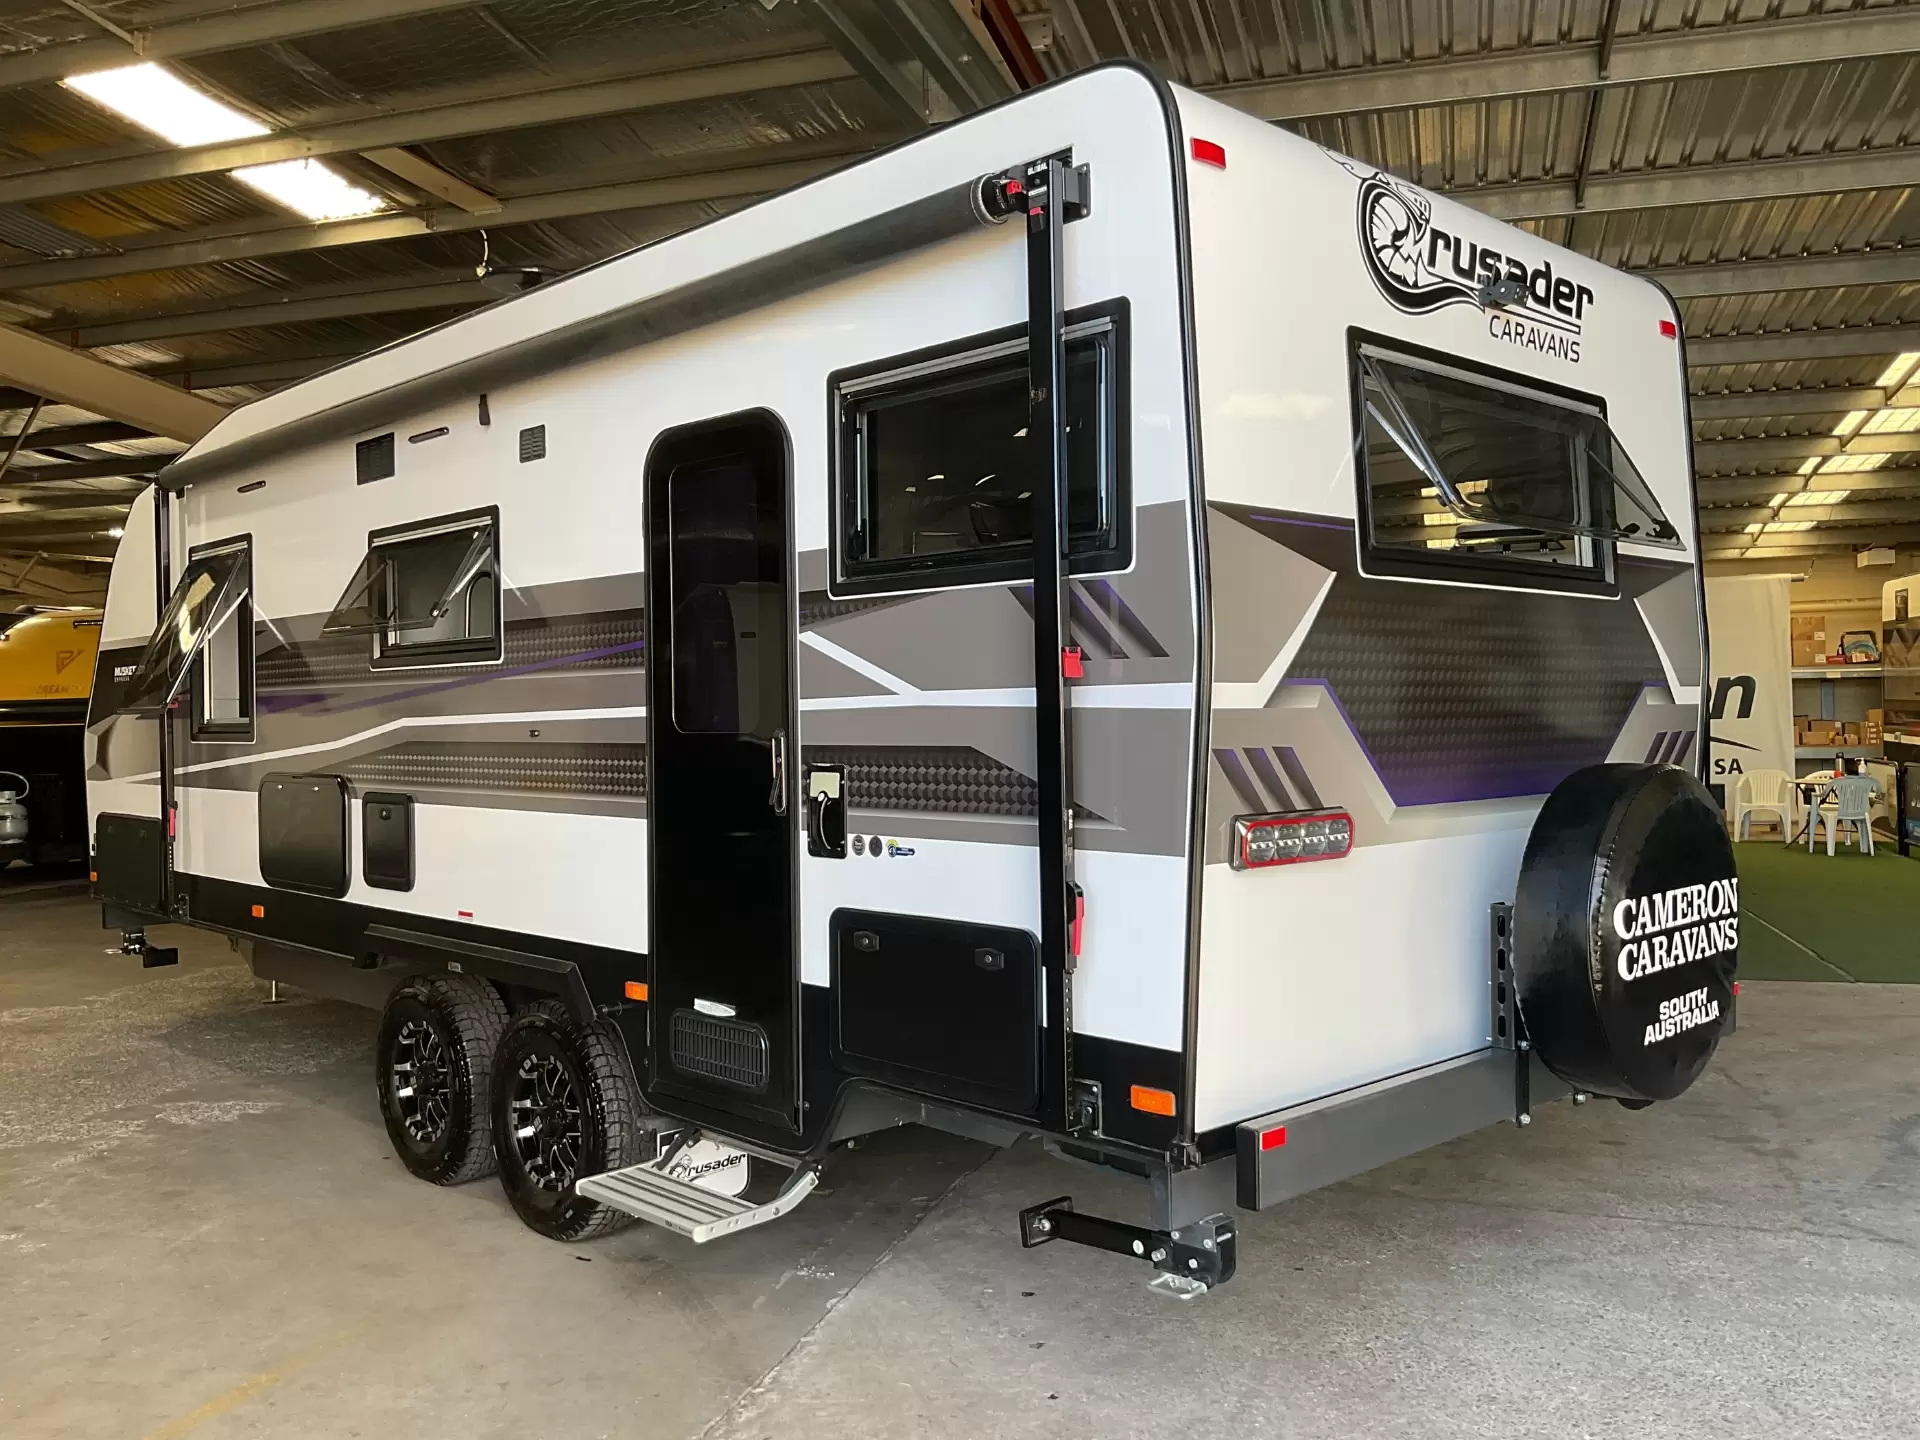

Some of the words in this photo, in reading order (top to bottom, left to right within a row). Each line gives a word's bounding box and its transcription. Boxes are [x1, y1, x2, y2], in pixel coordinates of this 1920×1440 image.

[1489, 314, 1581, 363] CARAVANS
[1709, 675, 1756, 719] n
[1714, 758, 1744, 775] SA
[1613, 878, 1738, 940] CAMERON
[1617, 917, 1738, 981] CARAVANS
[1644, 1000, 1720, 1046] AUSTRALIA
[1659, 986, 1708, 1020] SOUTH
